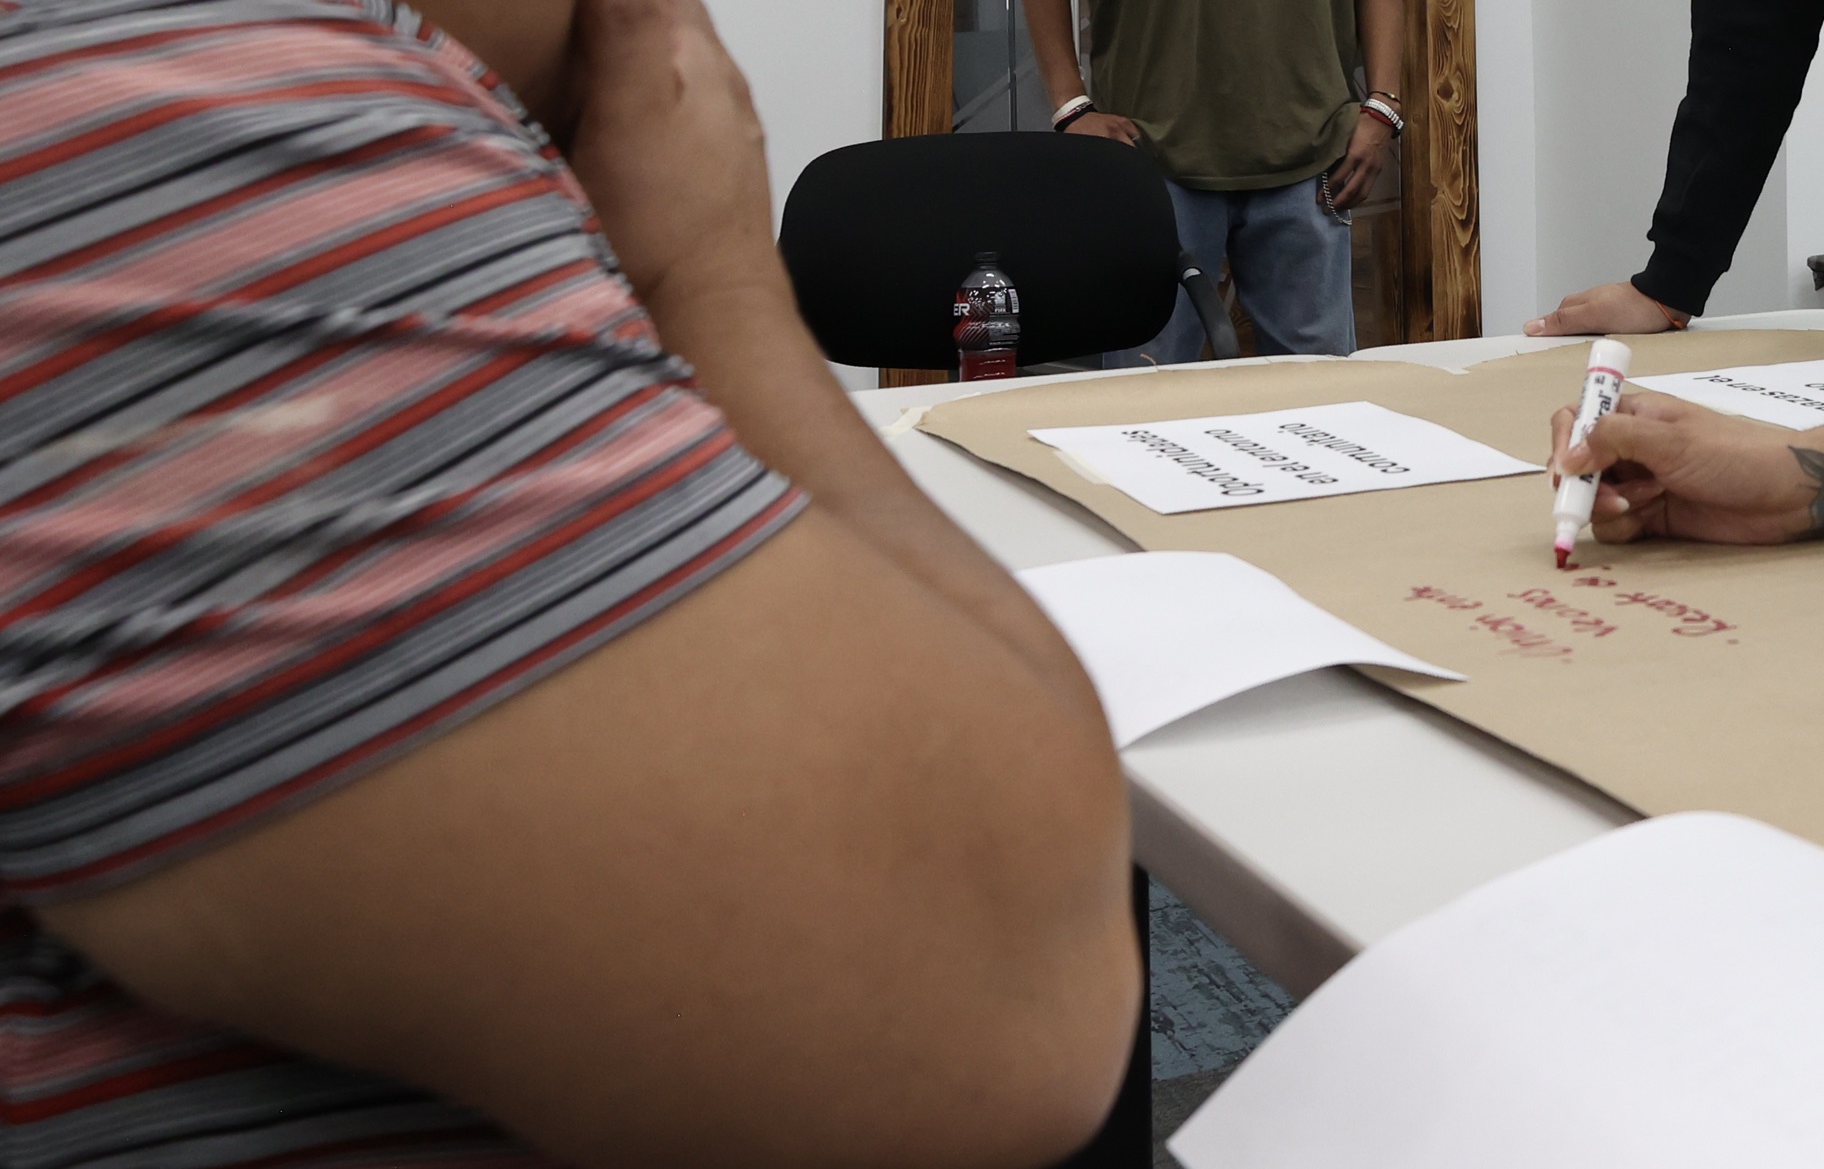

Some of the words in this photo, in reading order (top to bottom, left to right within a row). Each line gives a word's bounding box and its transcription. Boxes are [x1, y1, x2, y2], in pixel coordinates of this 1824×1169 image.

[1693, 375, 1733, 383] el
[1727, 382, 1766, 392] en
[1204, 428, 1289, 463] entorno
[1278, 422, 1411, 475] comunitario
[1121, 429, 1265, 497] Oportunidades
[1263, 461, 1310, 474] el
[1295, 471, 1339, 485] en
